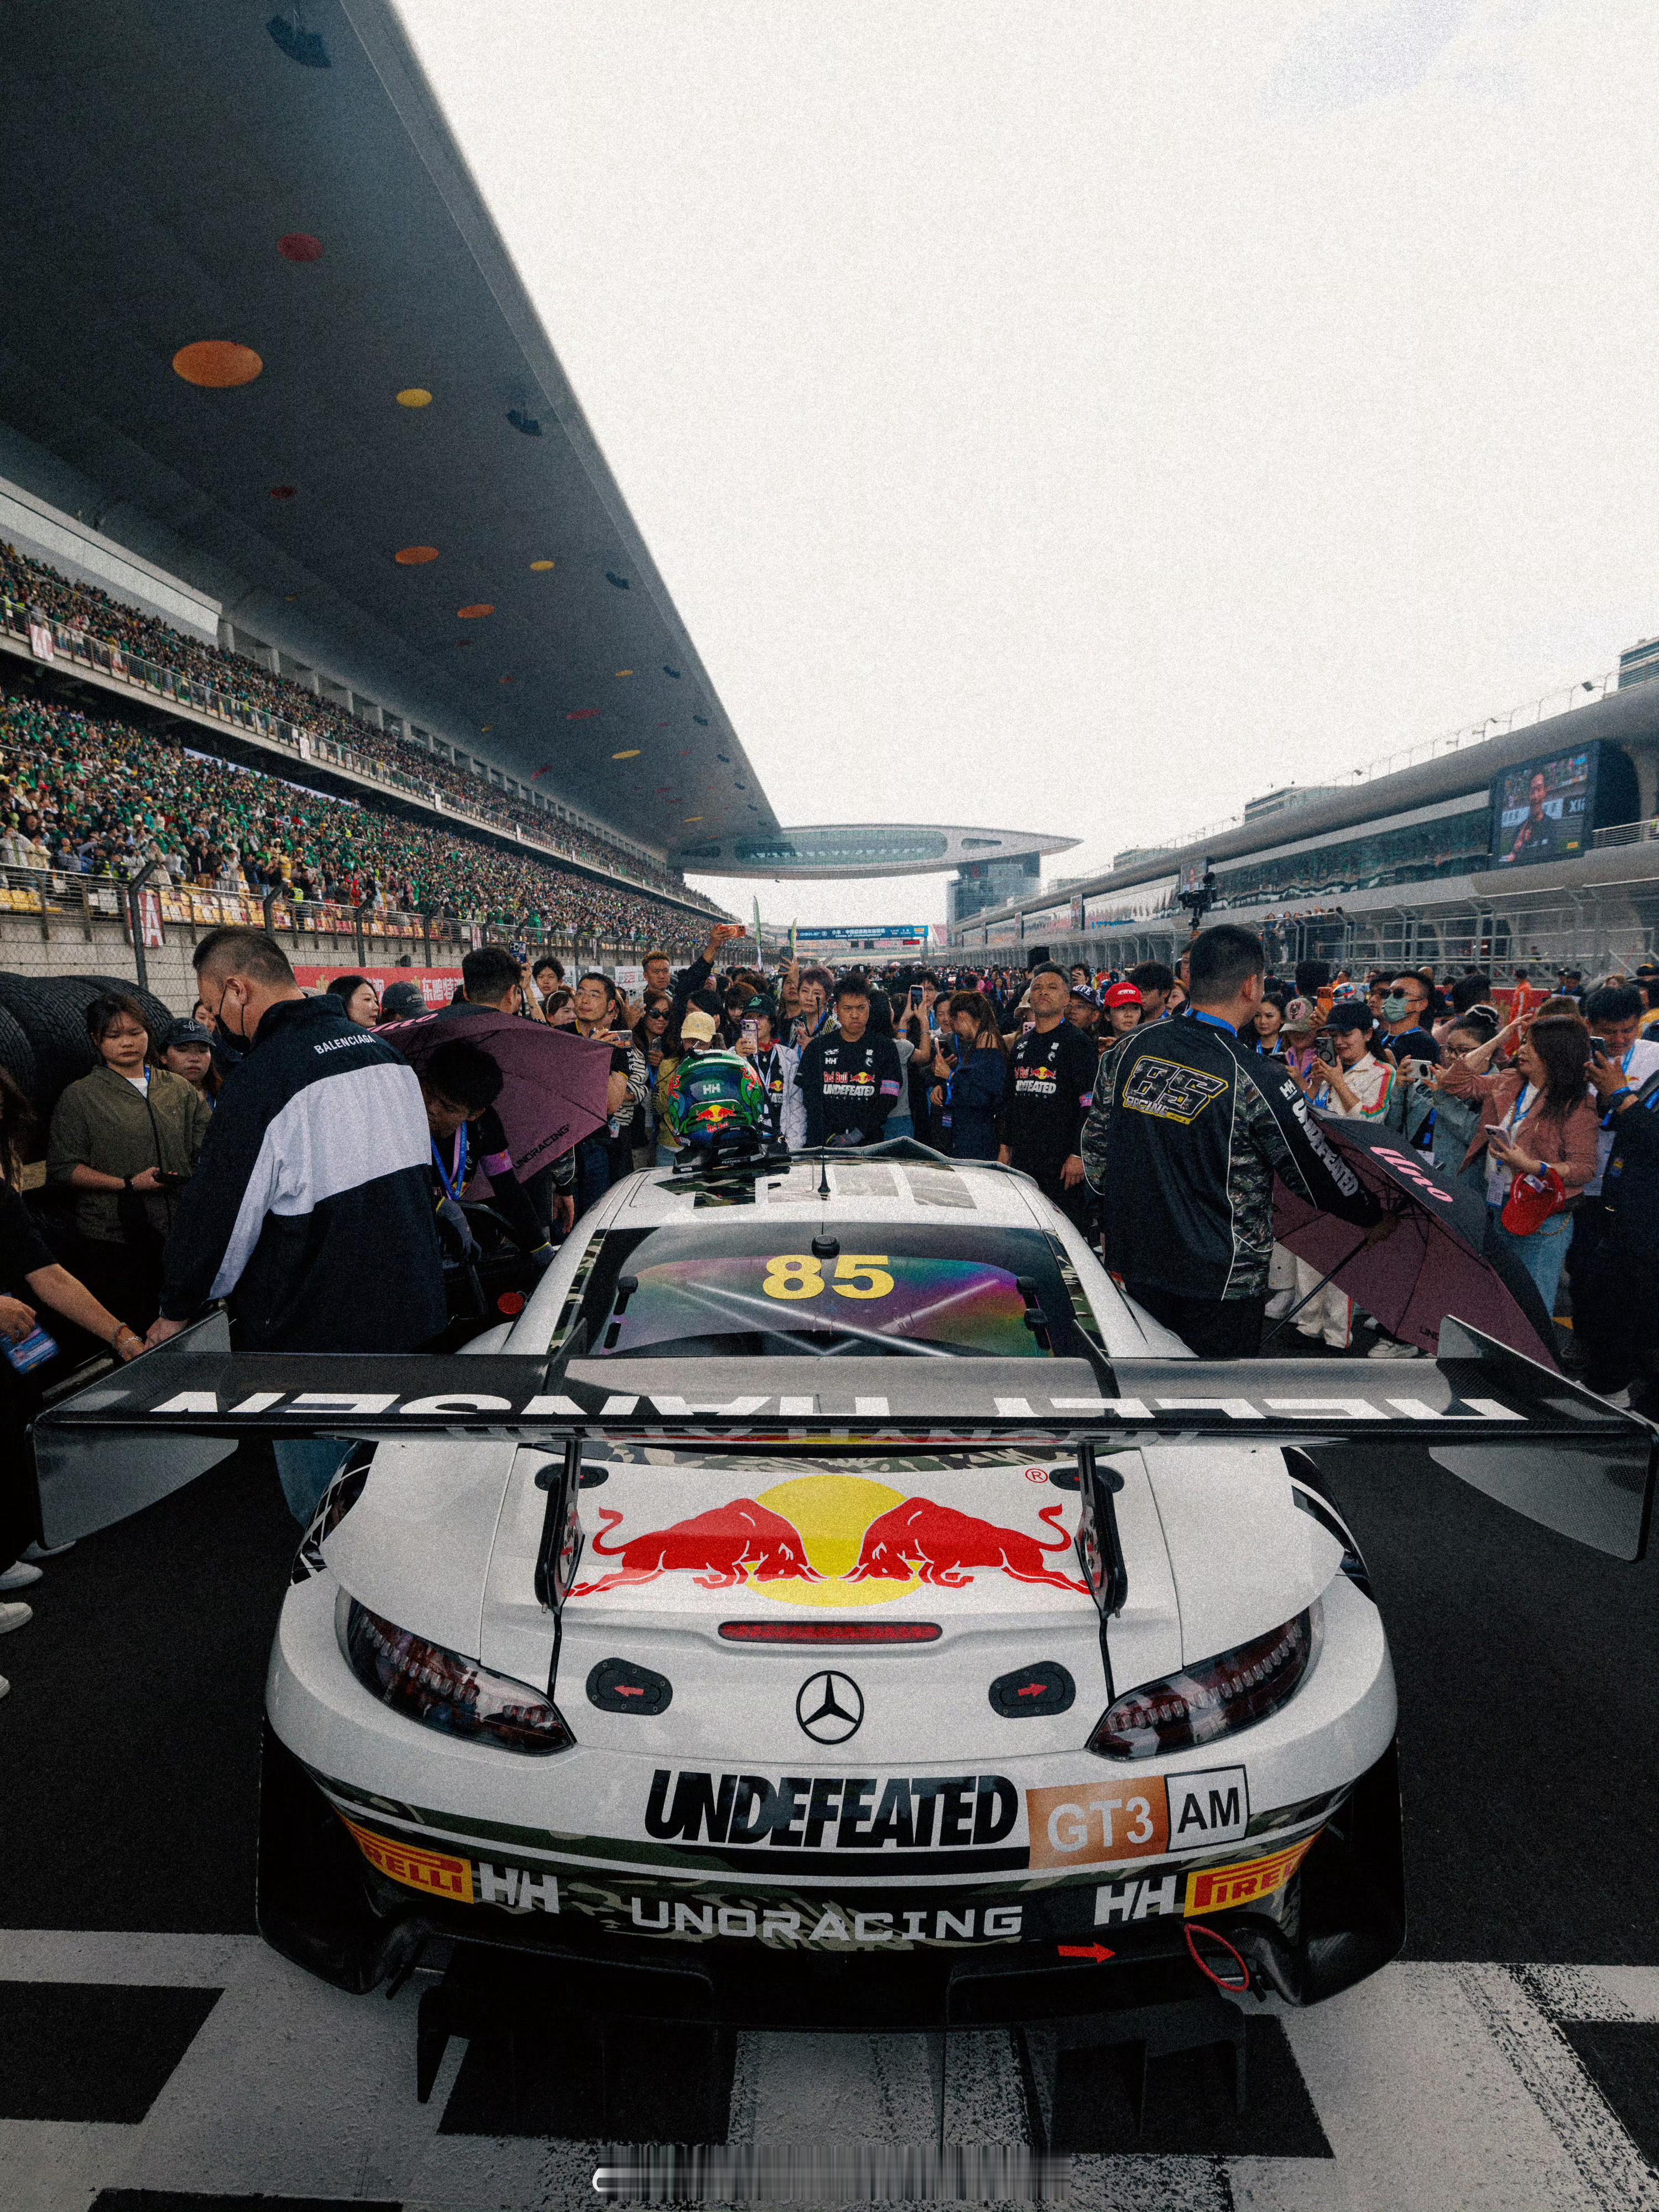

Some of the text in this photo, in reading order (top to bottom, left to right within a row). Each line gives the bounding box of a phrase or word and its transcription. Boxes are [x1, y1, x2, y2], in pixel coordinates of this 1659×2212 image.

[314, 1034, 377, 1055] BALENCIAGA
[702, 1083, 721, 1095] HH
[823, 1084, 875, 1097] UNDEFEATED
[1125, 1096, 1170, 1116] RACING
[1279, 1079, 1296, 1098] HH
[513, 1124, 570, 1170] UNORACING
[706, 1123, 718, 1133] Red
[762, 1254, 895, 1300] 85
[645, 1769, 1019, 1850] UNDEFEATED
[1047, 1796, 1154, 1853] GT3
[1177, 1787, 1240, 1834] AM
[479, 1862, 560, 1914] HH
[1094, 1875, 1177, 1926] HH
[632, 1897, 1023, 1944] UNORACING
